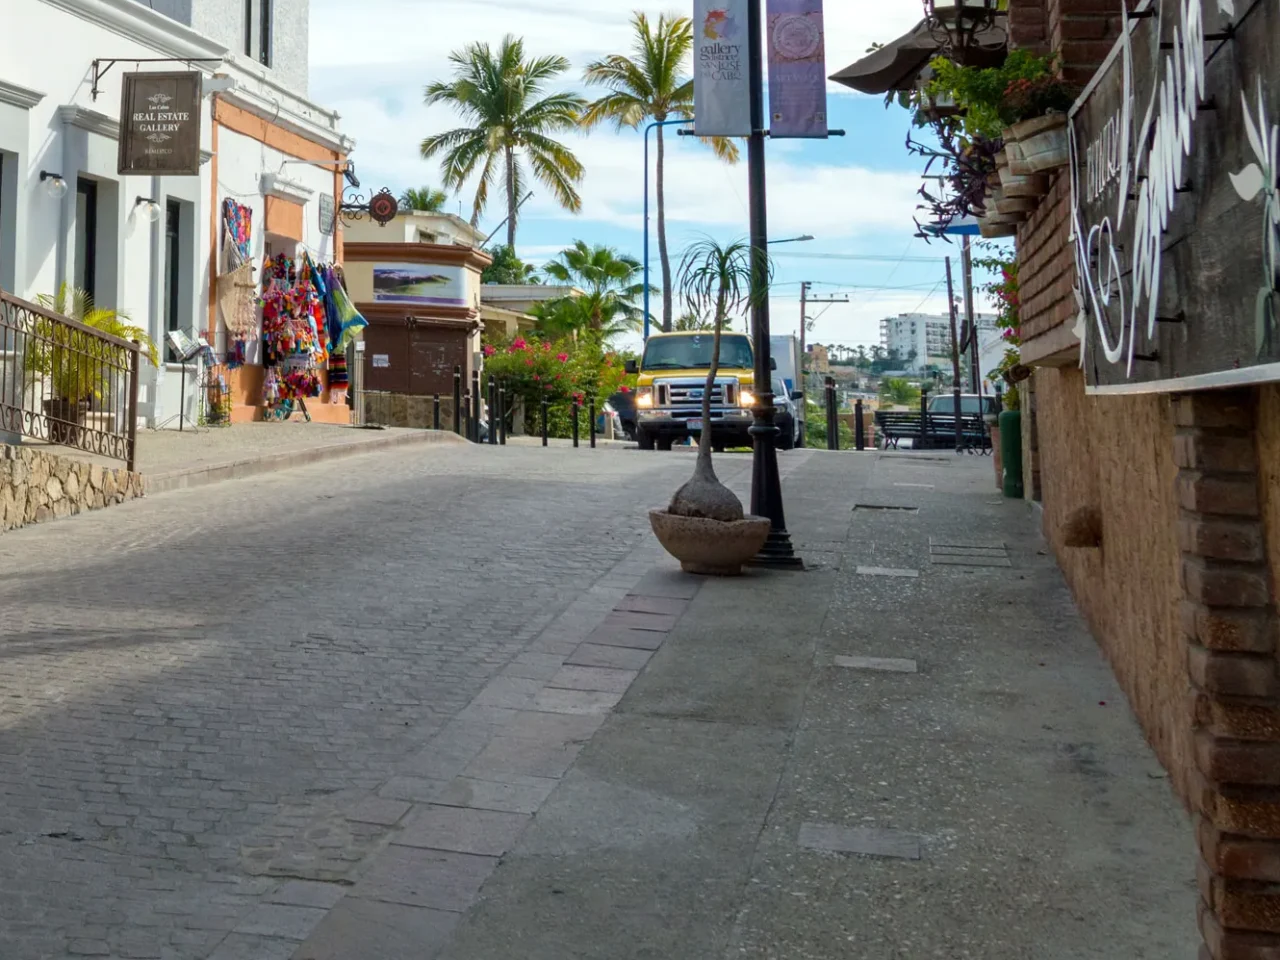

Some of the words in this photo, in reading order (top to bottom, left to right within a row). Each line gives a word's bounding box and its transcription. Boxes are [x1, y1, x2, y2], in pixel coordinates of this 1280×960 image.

[700, 42, 742, 61] gallery
[133, 112, 156, 121] REAL
[157, 112, 190, 121] ESTATE
[139, 123, 180, 132] GALLERY
